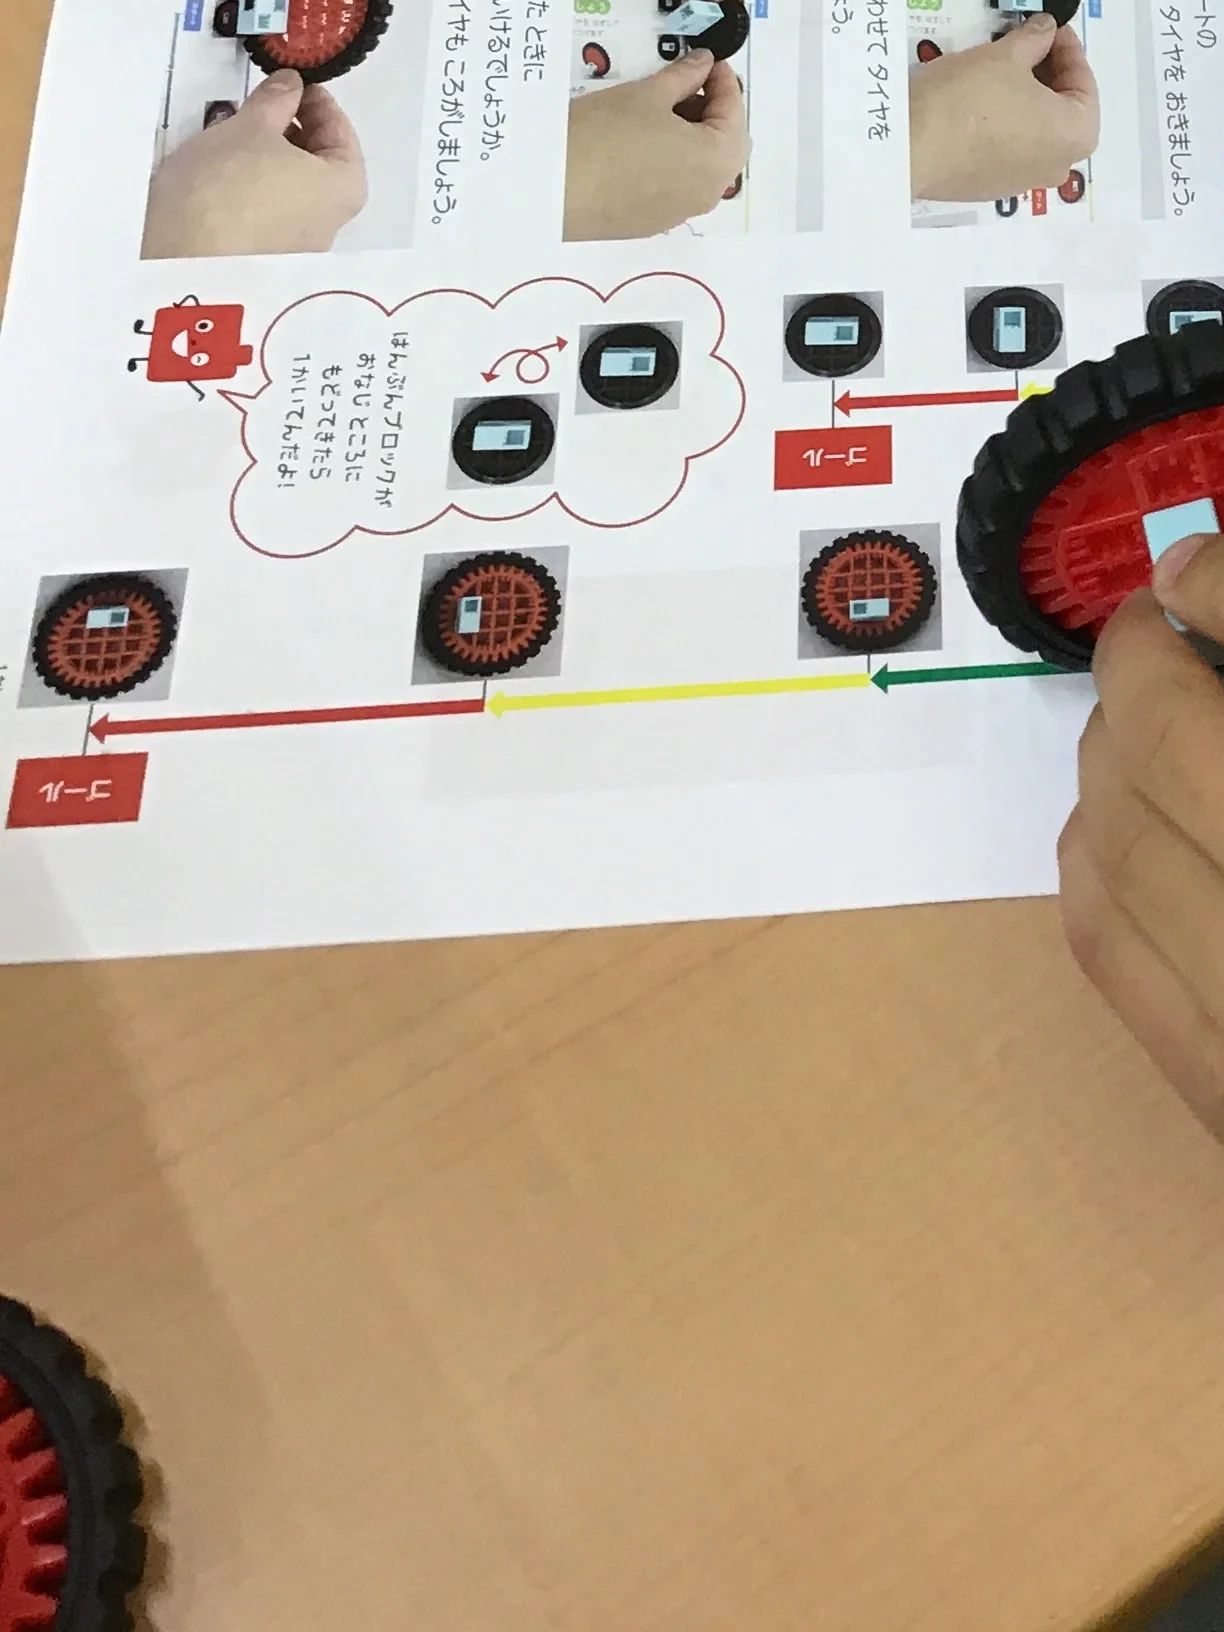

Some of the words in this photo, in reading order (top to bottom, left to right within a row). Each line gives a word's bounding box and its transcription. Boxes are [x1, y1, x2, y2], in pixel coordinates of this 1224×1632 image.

[522, 25, 548, 83] ときに
[1158, 4, 1186, 83] タイヤを
[866, 63, 891, 141] タイヤを
[430, 59, 468, 225] ころがしましょう。
[1164, 91, 1196, 217] おきましょう。
[352, 352, 377, 408] おなじ
[309, 364, 343, 481] もどってきたら
[344, 417, 370, 483] ところに
[374, 331, 410, 509] はんぶんブロックが
[801, 446, 868, 468] ゴール
[37, 779, 113, 803] ゴール
